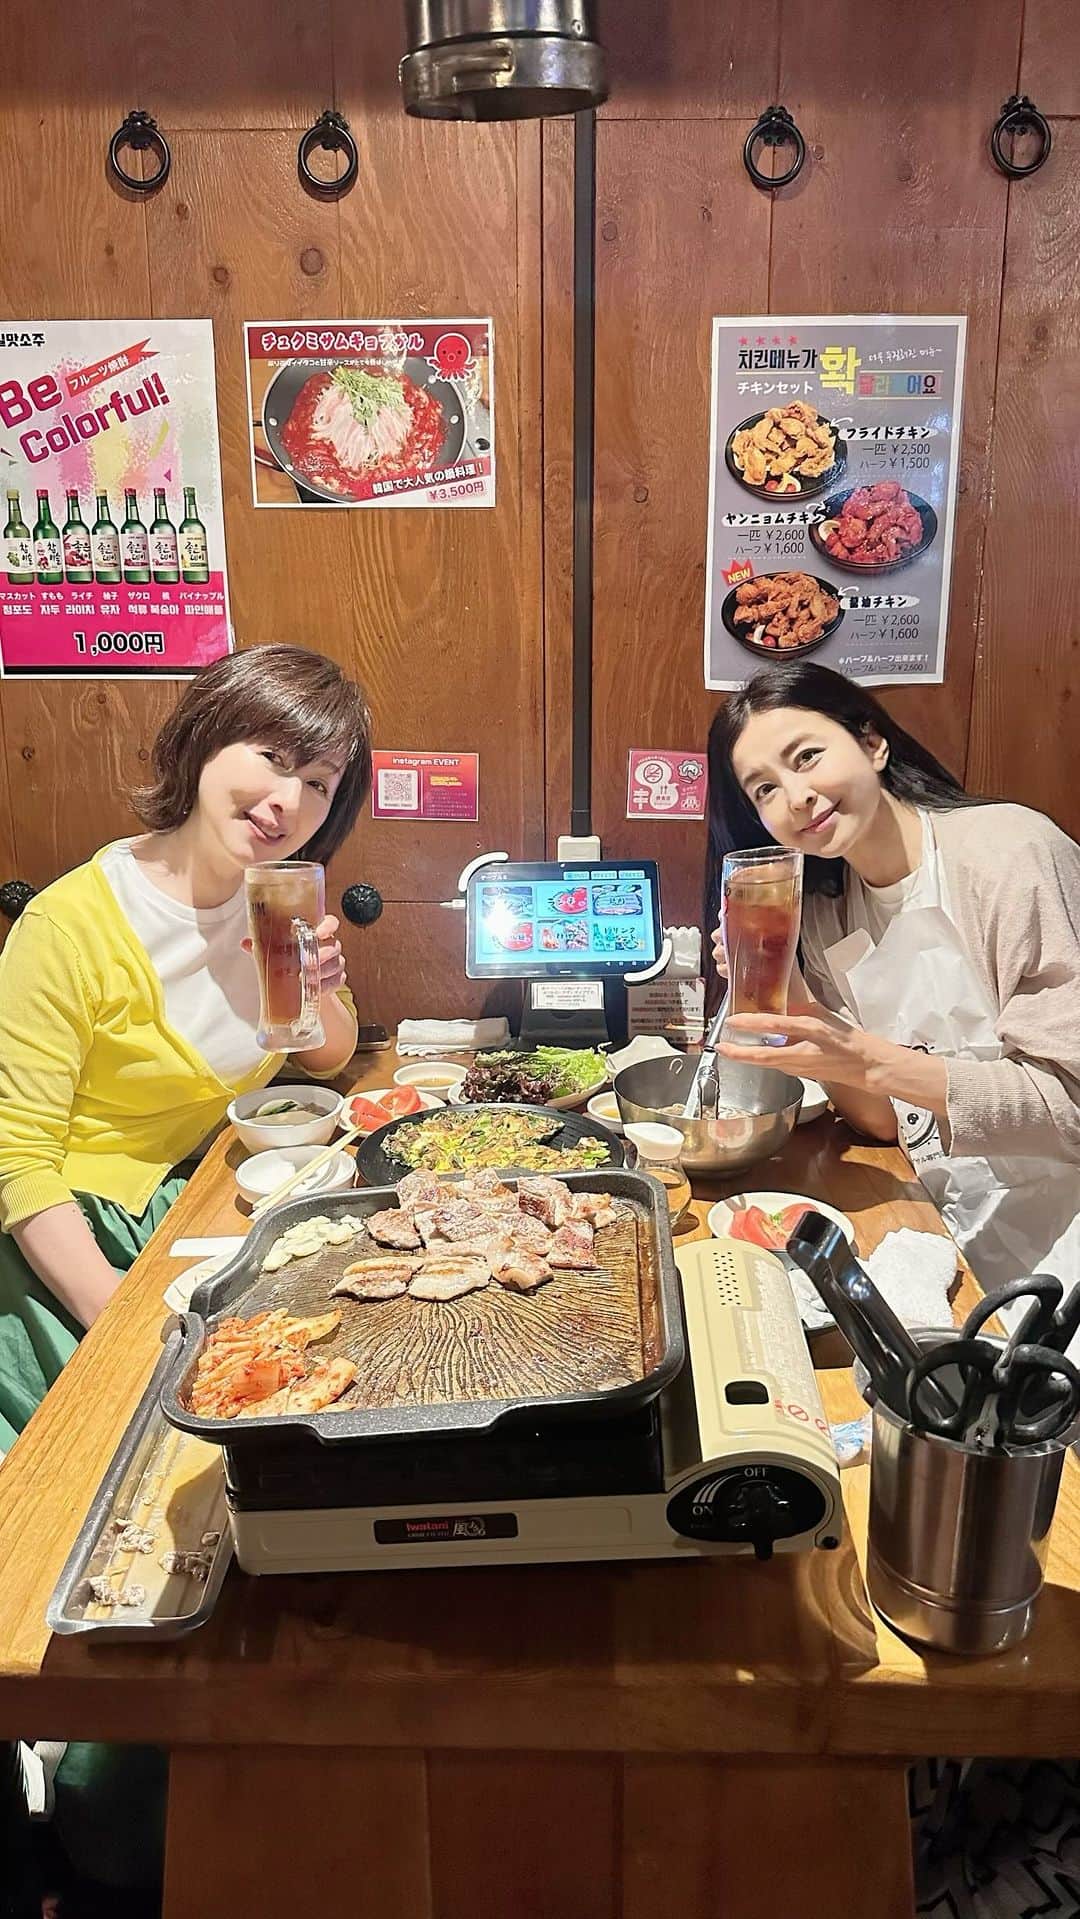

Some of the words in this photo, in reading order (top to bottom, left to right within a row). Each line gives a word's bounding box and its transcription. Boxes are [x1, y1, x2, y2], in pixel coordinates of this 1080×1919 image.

[737, 380, 814, 396] チキンセット
[0, 374, 63, 429] Be
[19, 372, 171, 464] Colorful!
[846, 428, 931, 440] フライドチキン
[726, 512, 826, 526] ヤンニョムチキン
[728, 569, 751, 583] NEW
[74, 632, 166, 656] 1,000円
[744, 1467, 769, 1478] OFF
[692, 1506, 713, 1516] ON
